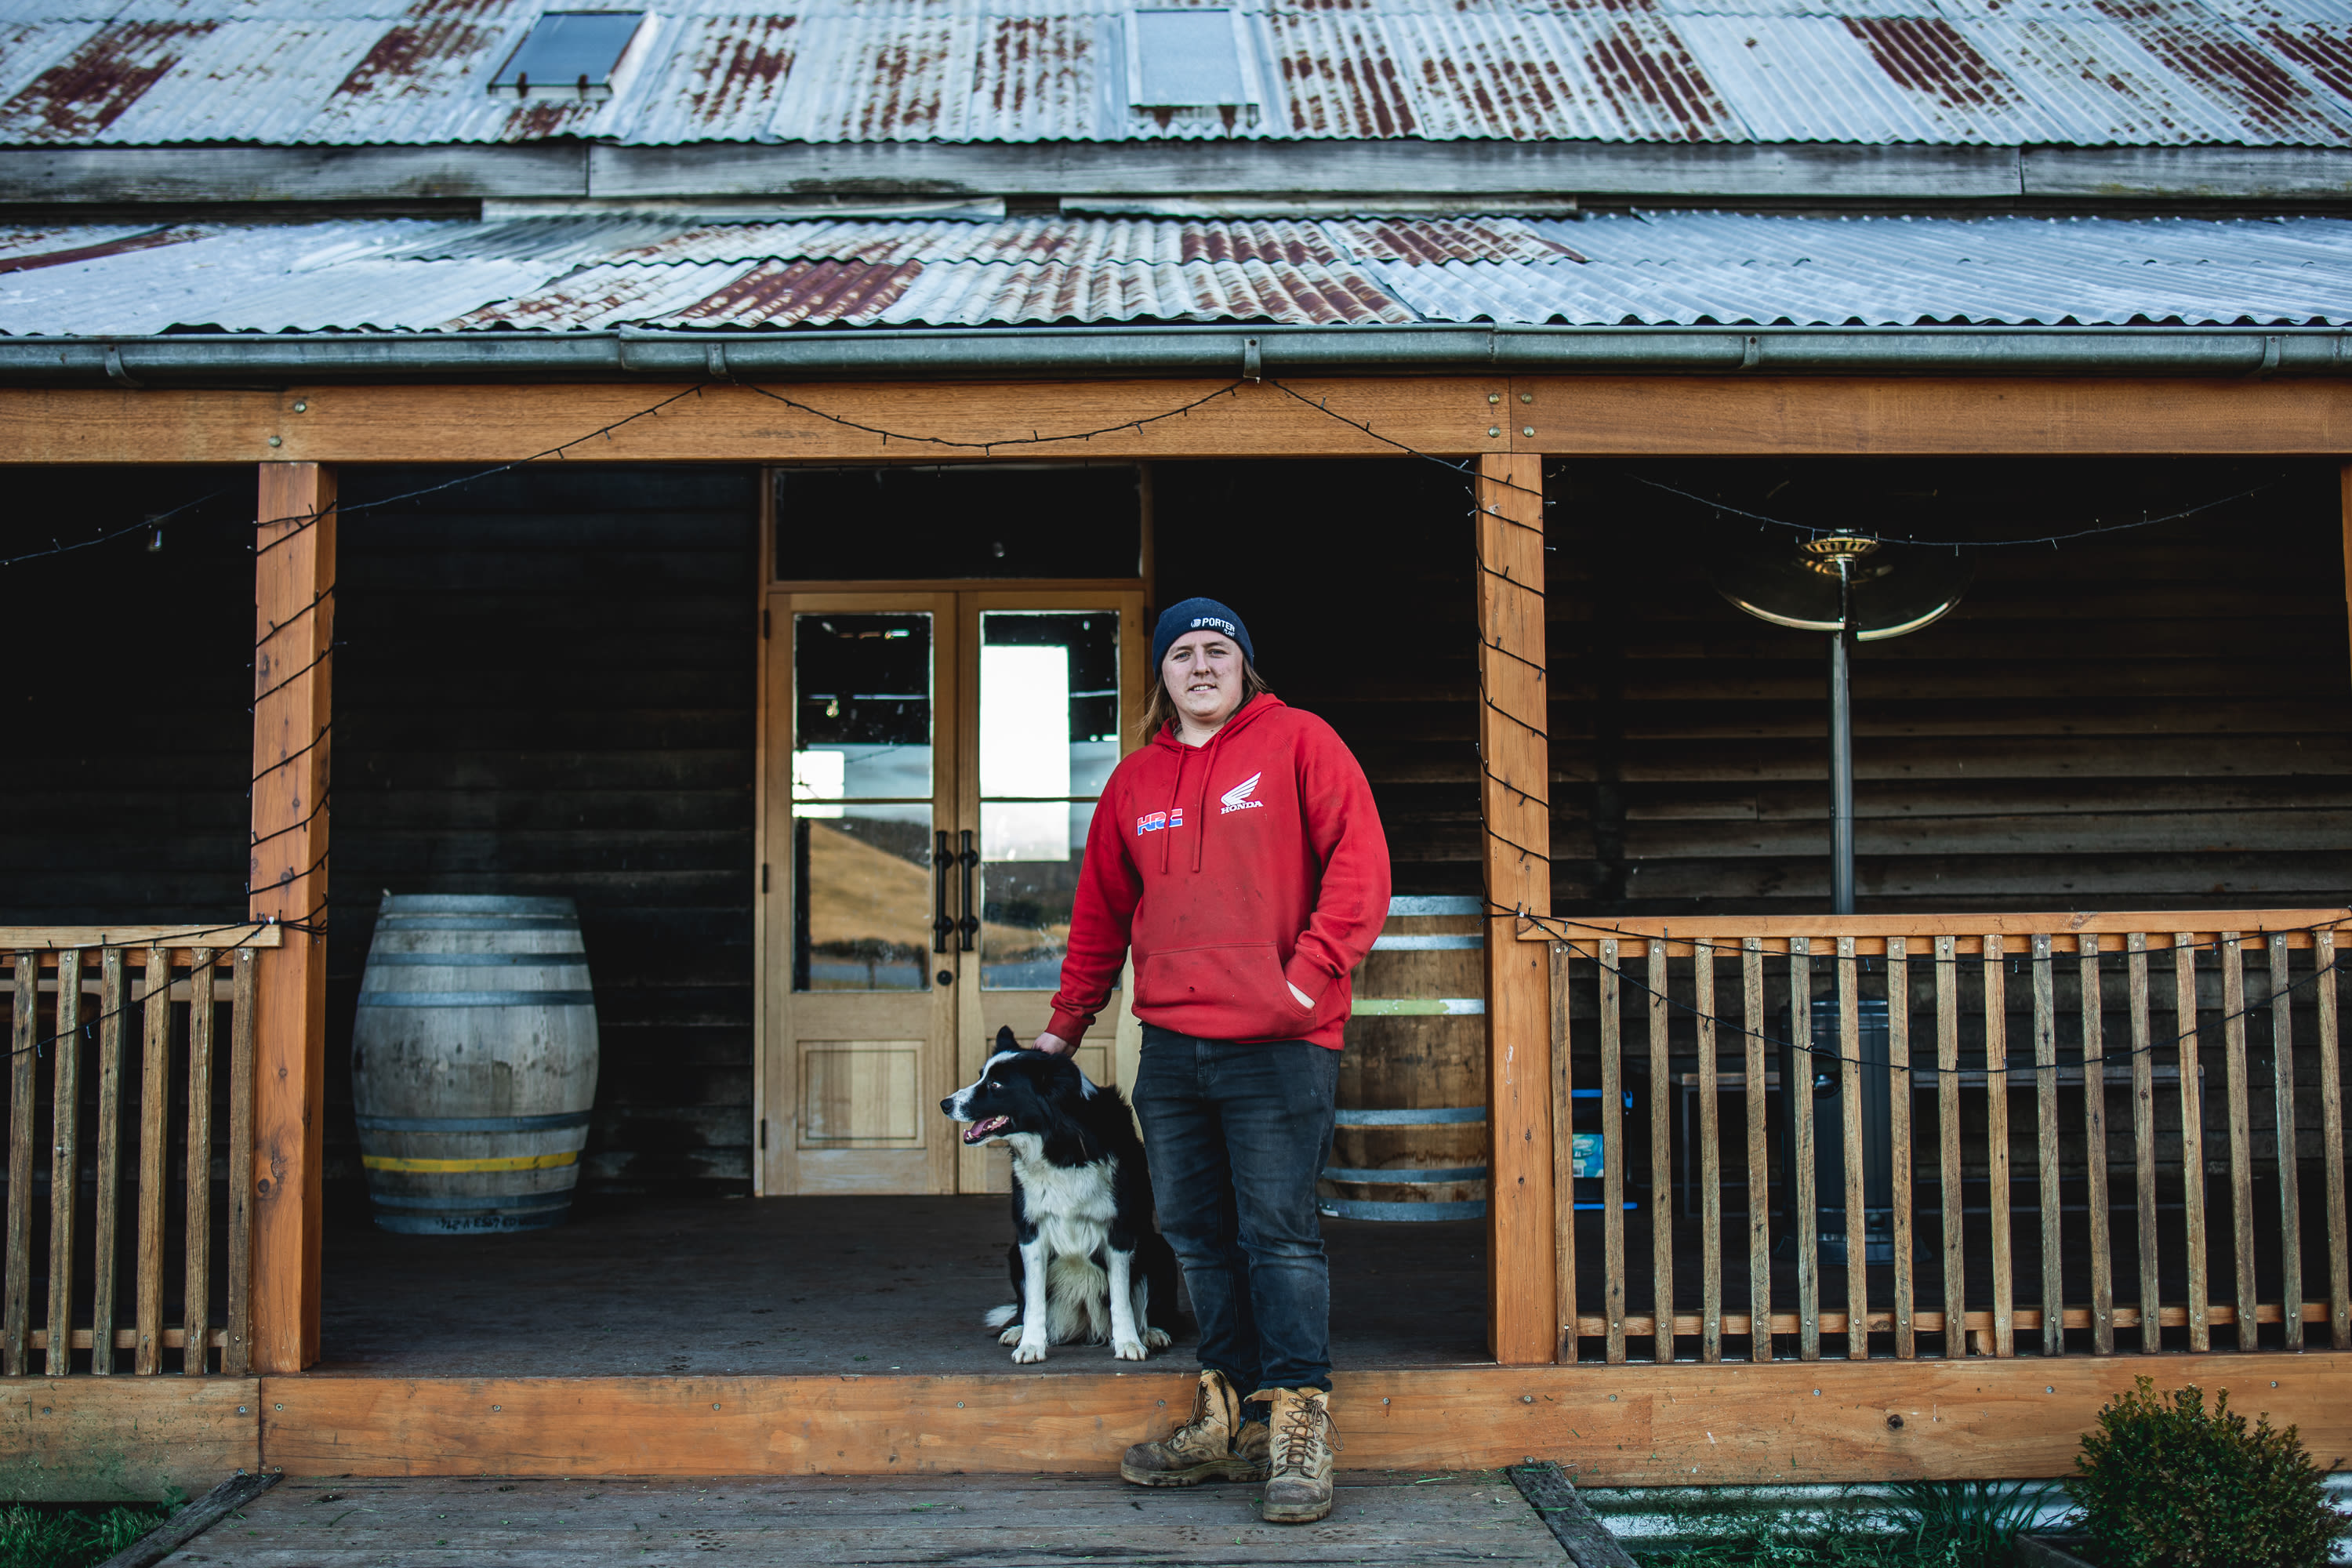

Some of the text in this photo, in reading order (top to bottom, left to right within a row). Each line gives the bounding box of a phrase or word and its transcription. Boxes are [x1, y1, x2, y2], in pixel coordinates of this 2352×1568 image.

[1202, 617, 1235, 632] PORTER
[1221, 800, 1264, 815] HONDA
[1138, 808, 1182, 837] HRC
